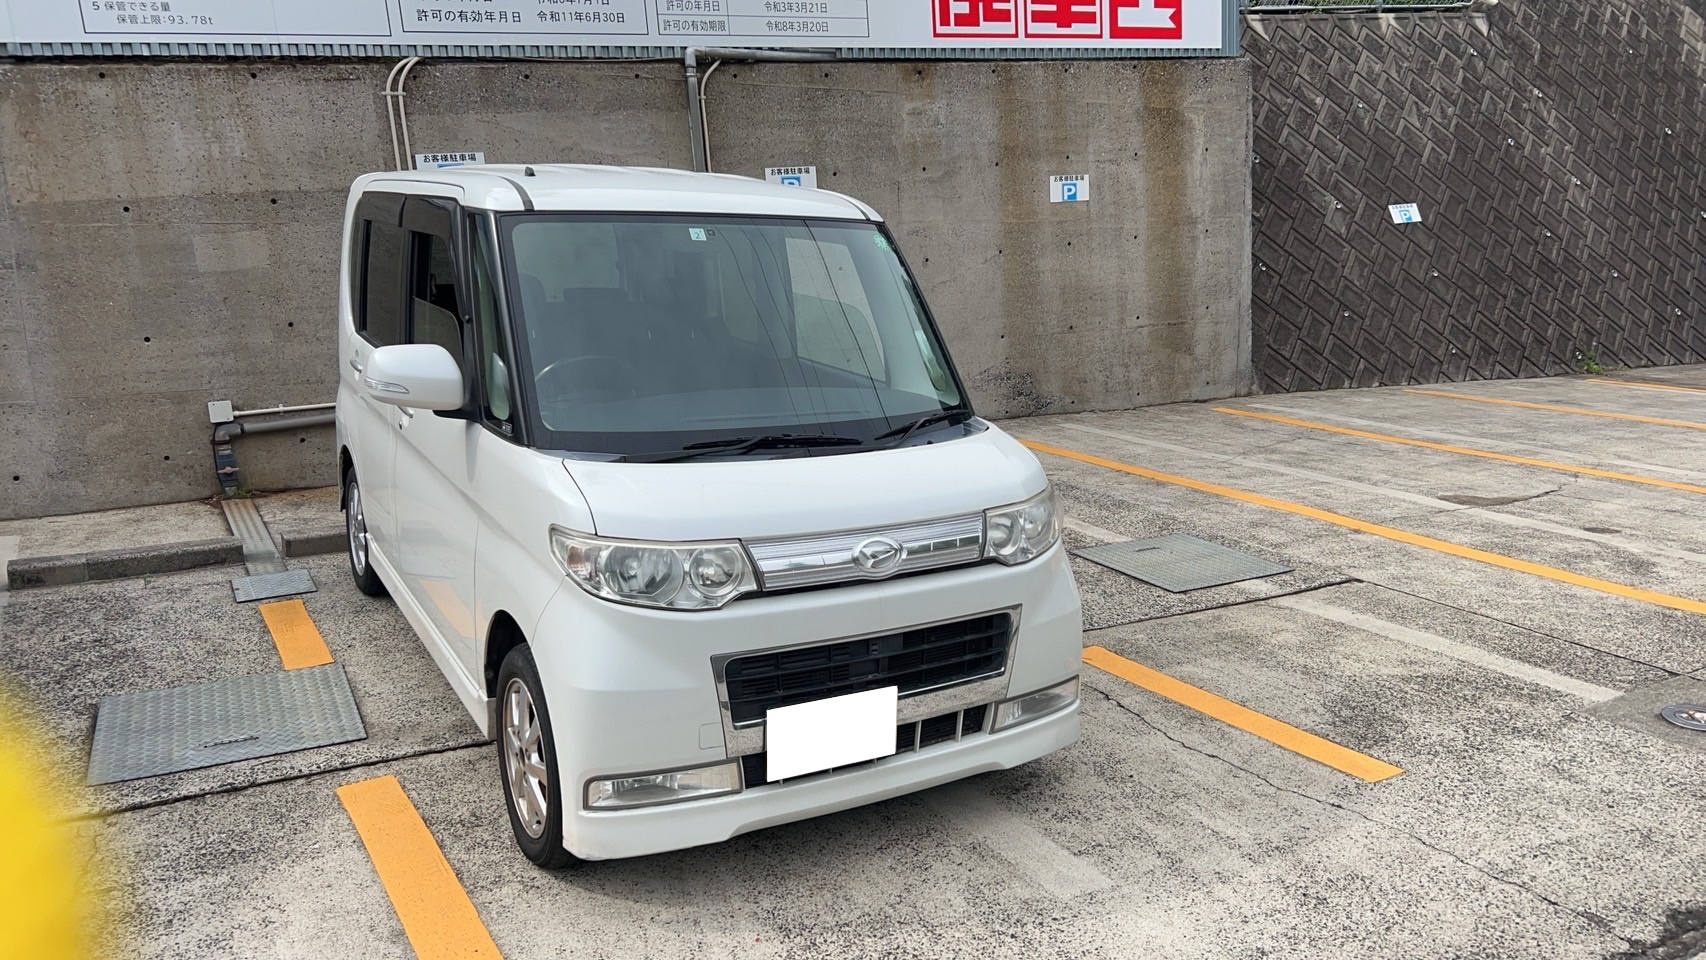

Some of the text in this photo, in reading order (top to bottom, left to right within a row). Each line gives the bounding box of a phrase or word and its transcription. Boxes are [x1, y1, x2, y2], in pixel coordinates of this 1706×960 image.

[92, 1, 171, 12] 5 保管できる量
[666, 0, 720, 12] 許可の年月日
[764, 1, 828, 14] 令和3年3月21日
[416, 9, 625, 23] 許可の有効年月日 令和11年6月30日
[663, 20, 727, 32] 許可の有効期限
[765, 20, 829, 33] 令和8年3月20日
[423, 153, 477, 163] お客様駐車場
[1063, 185, 1076, 200] P
[1400, 210, 1412, 222] P
